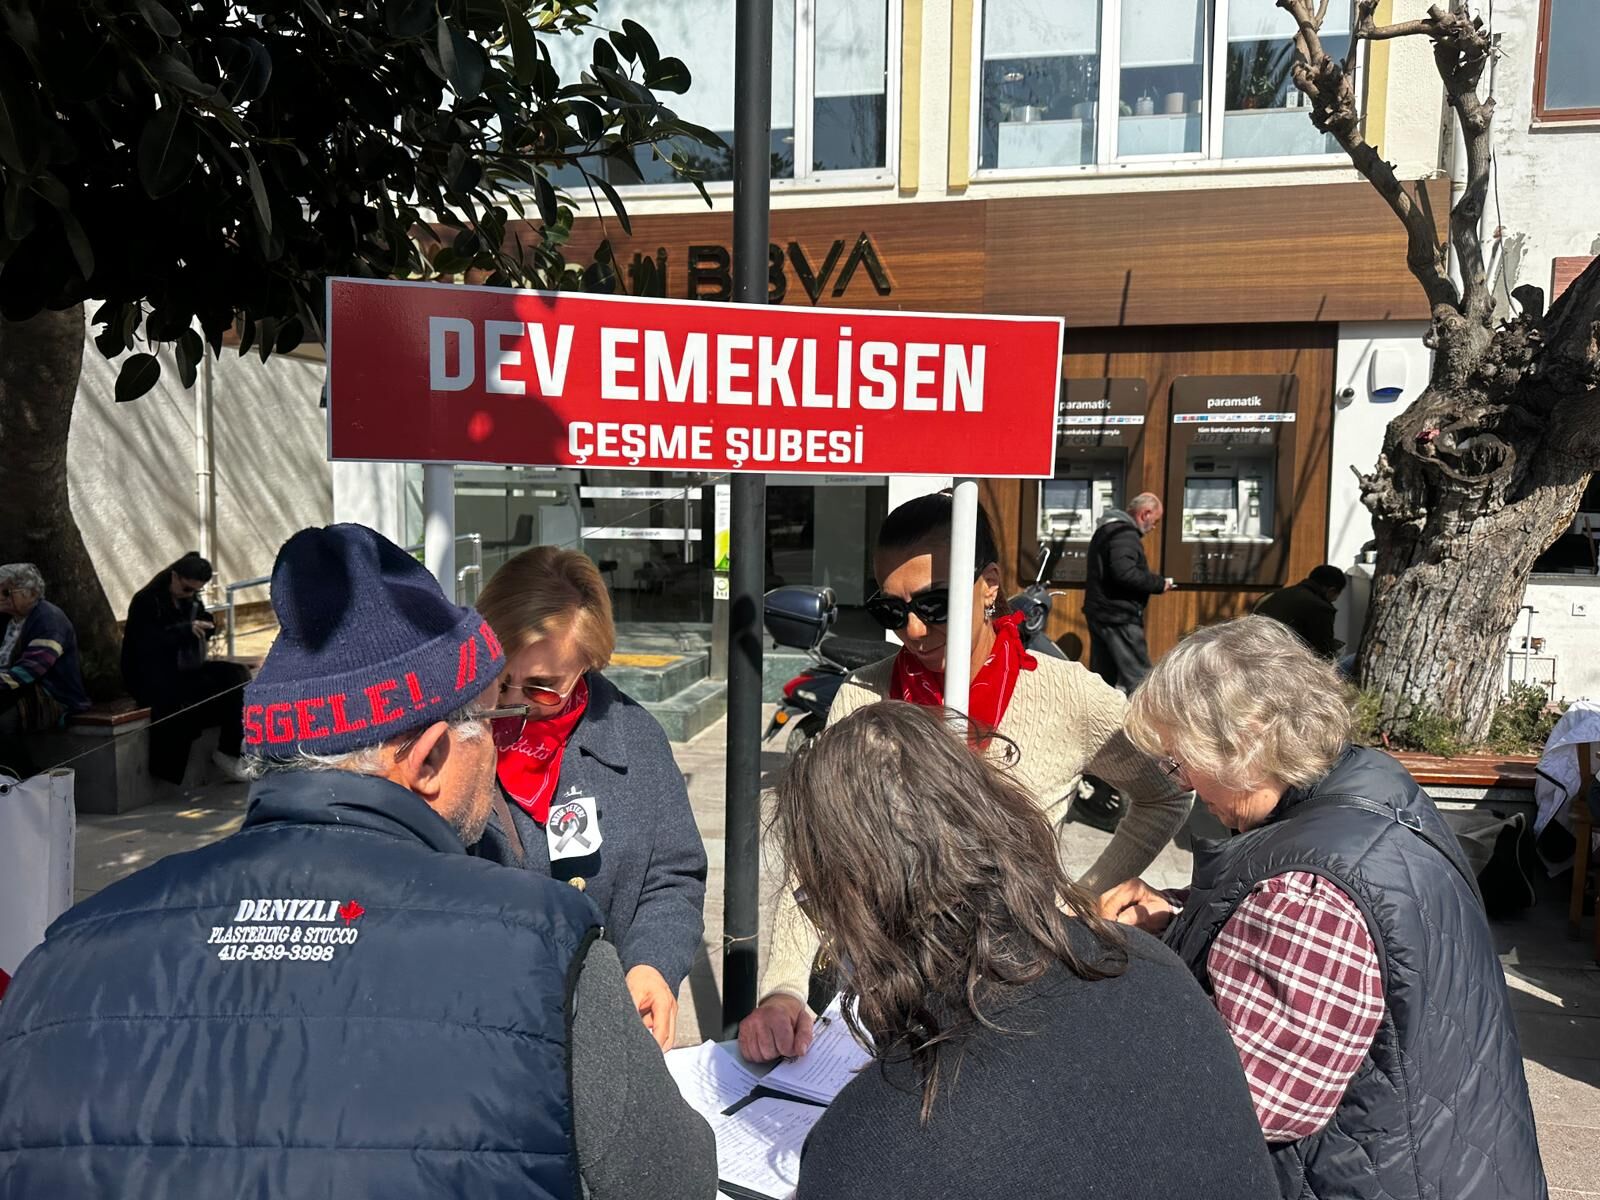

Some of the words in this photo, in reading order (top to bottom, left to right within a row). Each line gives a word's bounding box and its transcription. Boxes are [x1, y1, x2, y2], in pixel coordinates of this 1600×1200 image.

[429, 316, 575, 397] DEV
[600, 326, 986, 412] EMEKLİSEN
[1060, 399, 1111, 412] paramatik
[1207, 395, 1261, 409] paramatik
[568, 421, 713, 465] ÇEŞME
[726, 425, 863, 468] ŞUBESİ
[234, 899, 341, 922] DENIZLI
[207, 926, 290, 944] PLASTERING
[290, 926, 302, 943] &
[303, 927, 358, 944] STUCCO
[218, 944, 334, 961] 416-839-3998
